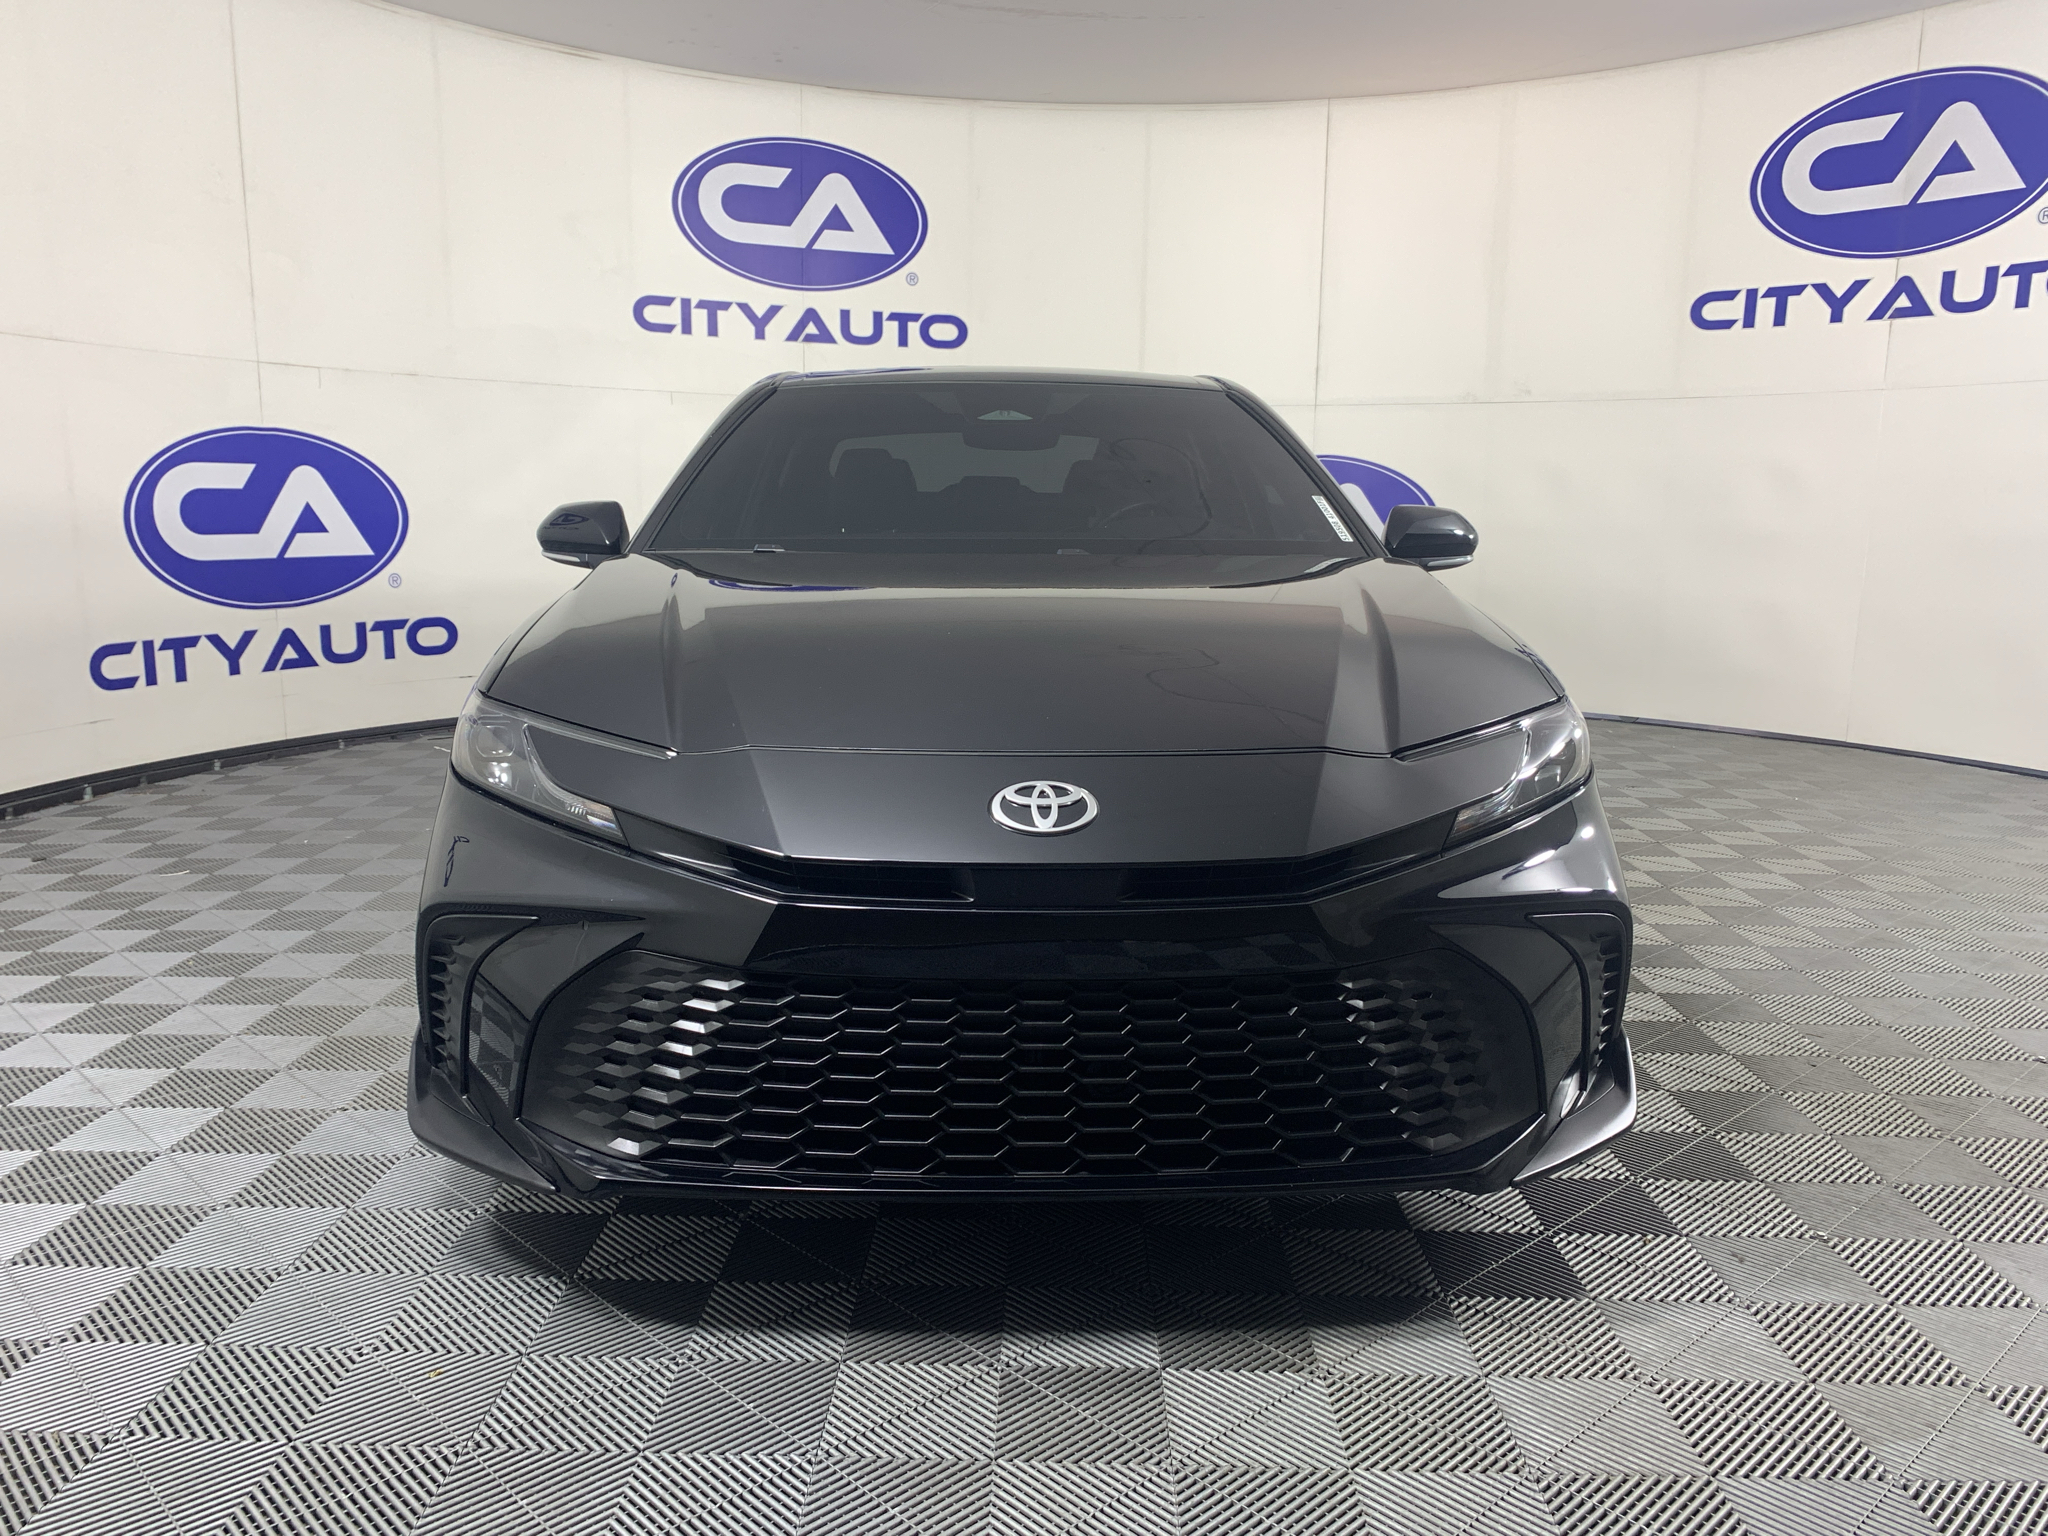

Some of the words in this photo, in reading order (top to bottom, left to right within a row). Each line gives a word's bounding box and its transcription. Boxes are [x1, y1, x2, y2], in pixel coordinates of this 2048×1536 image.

[1781, 101, 2027, 216] CA
[697, 162, 895, 255] CA
[632, 295, 783, 340] CITY
[785, 307, 968, 349] AUTO
[1690, 278, 1873, 331] CITY
[1867, 260, 2048, 321] AUT
[152, 461, 375, 561] CA
[89, 629, 258, 691] CITY
[261, 616, 459, 672] AUTO
